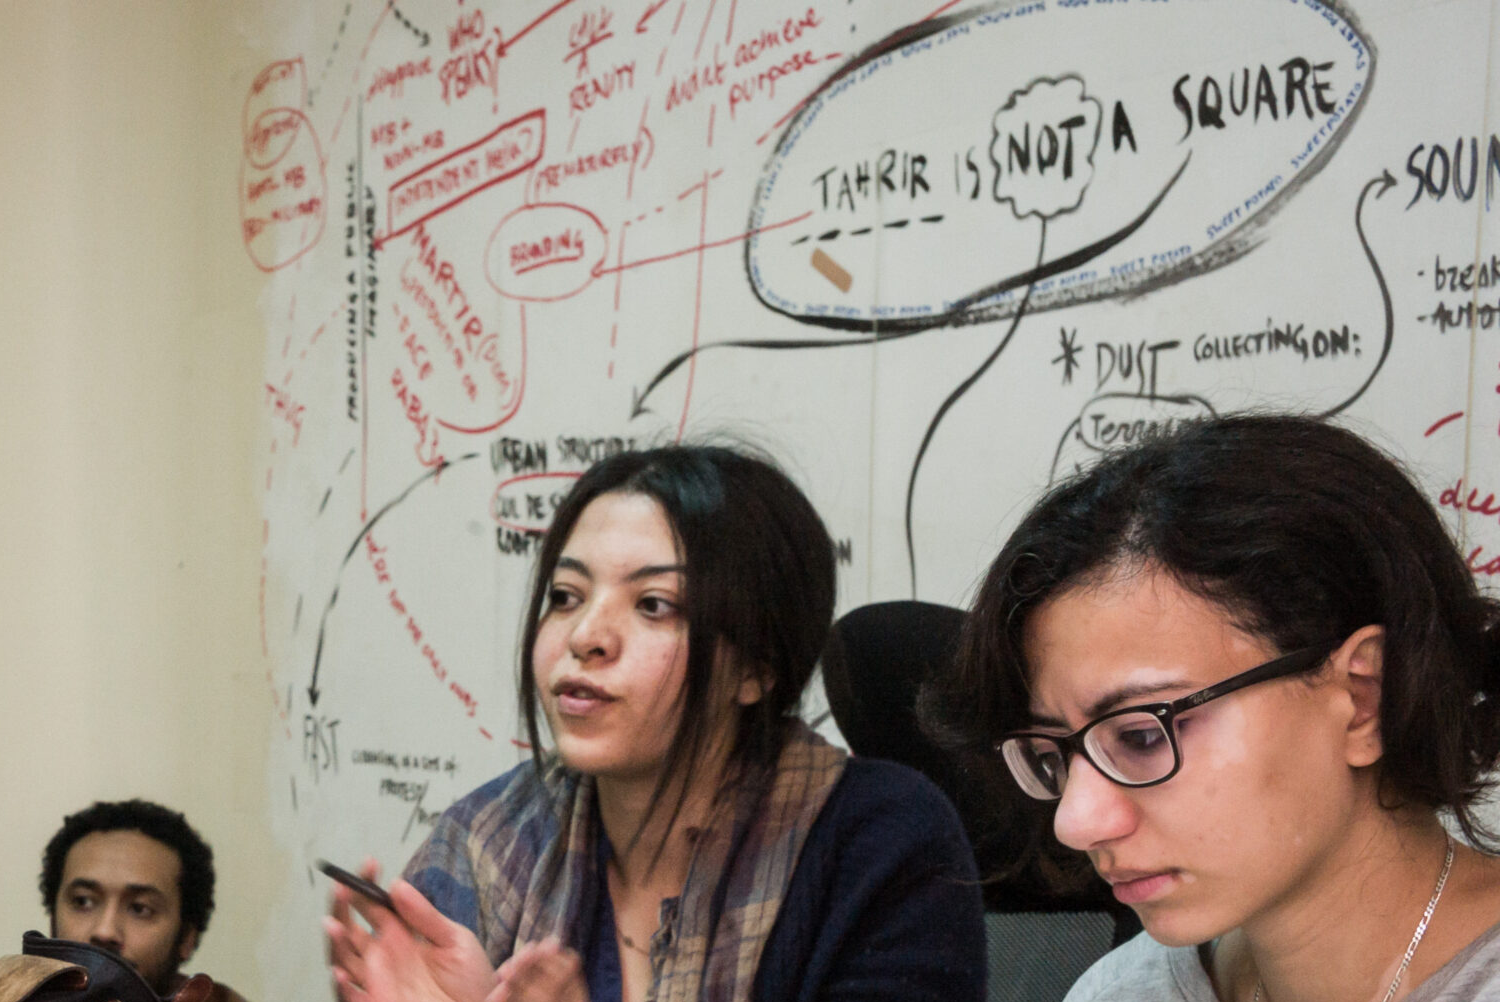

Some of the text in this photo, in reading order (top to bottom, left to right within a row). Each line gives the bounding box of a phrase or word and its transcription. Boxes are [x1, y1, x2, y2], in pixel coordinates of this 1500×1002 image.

[728, 49, 818, 121] purpose
[811, 55, 1338, 213] TAHRIR IS NOT A SQUARE
[1096, 339, 1182, 406] DUST
